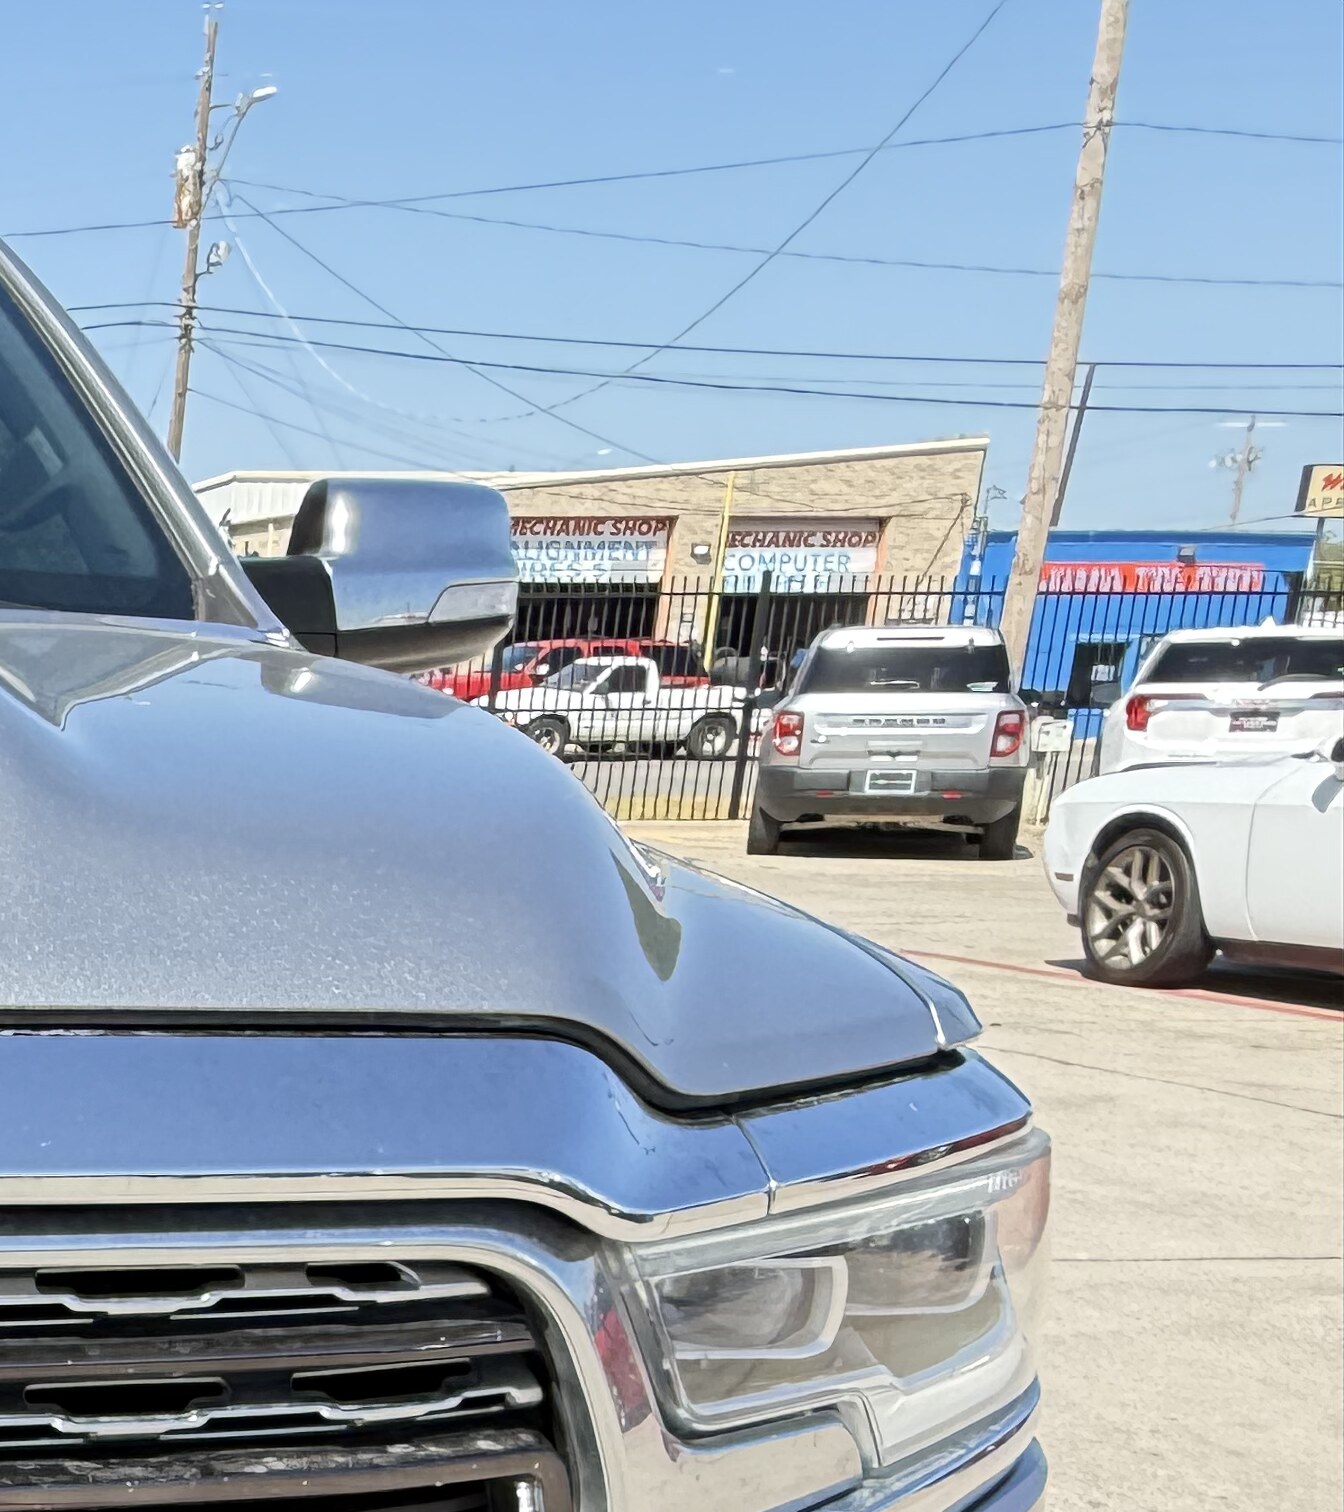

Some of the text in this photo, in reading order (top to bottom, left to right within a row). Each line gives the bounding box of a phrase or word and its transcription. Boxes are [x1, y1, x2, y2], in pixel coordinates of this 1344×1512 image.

[609, 518, 669, 536] SHOP
[726, 530, 878, 548] ECHANIC SHOP
[724, 552, 852, 573] COMPUTER
